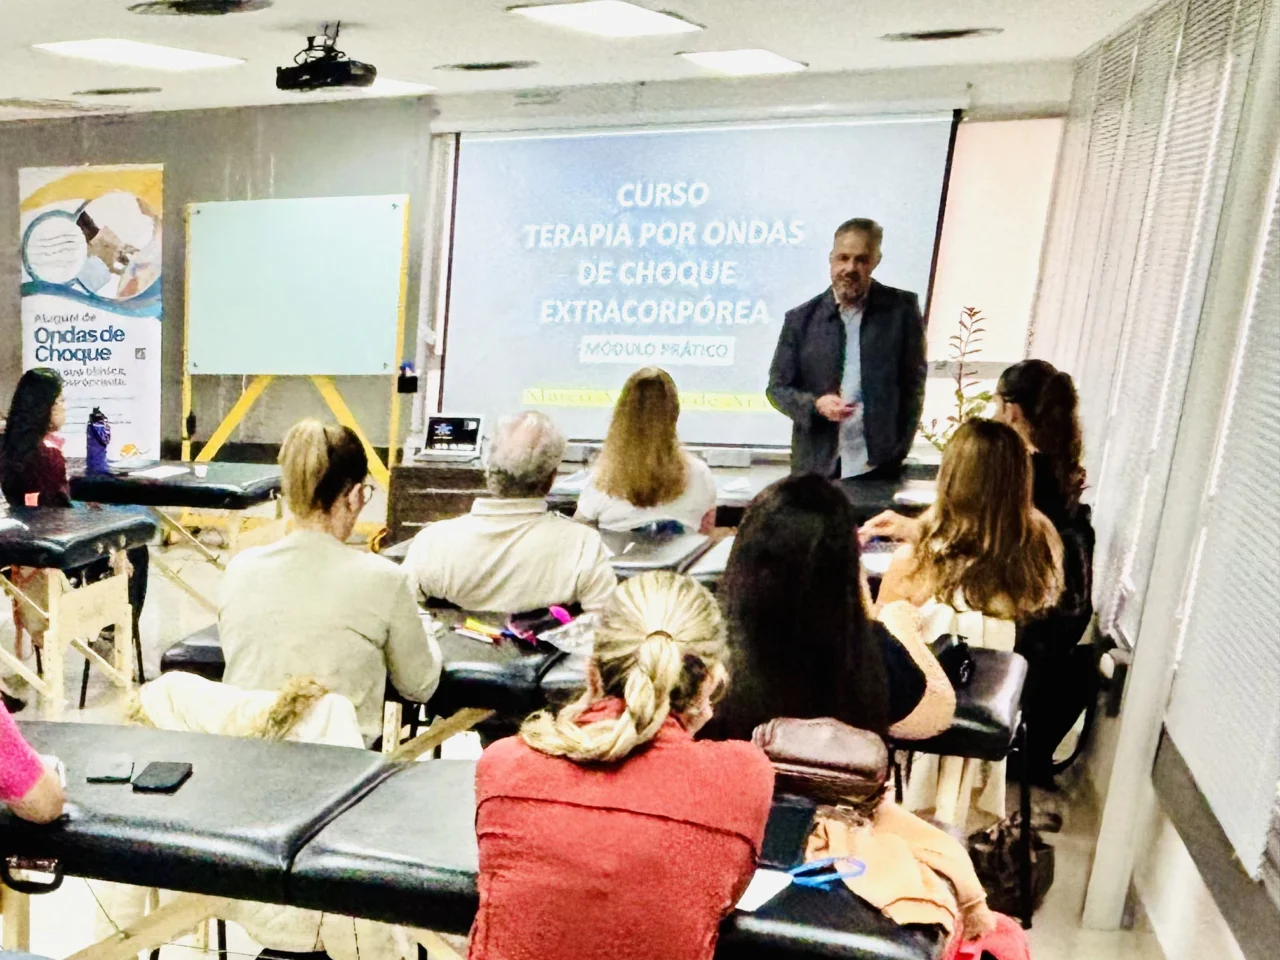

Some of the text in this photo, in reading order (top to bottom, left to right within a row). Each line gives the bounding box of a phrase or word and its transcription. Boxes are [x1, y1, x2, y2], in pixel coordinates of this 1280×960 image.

[617, 181, 710, 208] CURSO
[525, 219, 804, 249] TERAPIA POR ONDAS
[578, 259, 737, 288] DE CHOQUE
[540, 295, 769, 325] EXTRACORPÓREA
[34, 325, 125, 344] Ondas de
[35, 344, 112, 366] Choque
[585, 339, 728, 358] MÓDULO PRÁTICO
